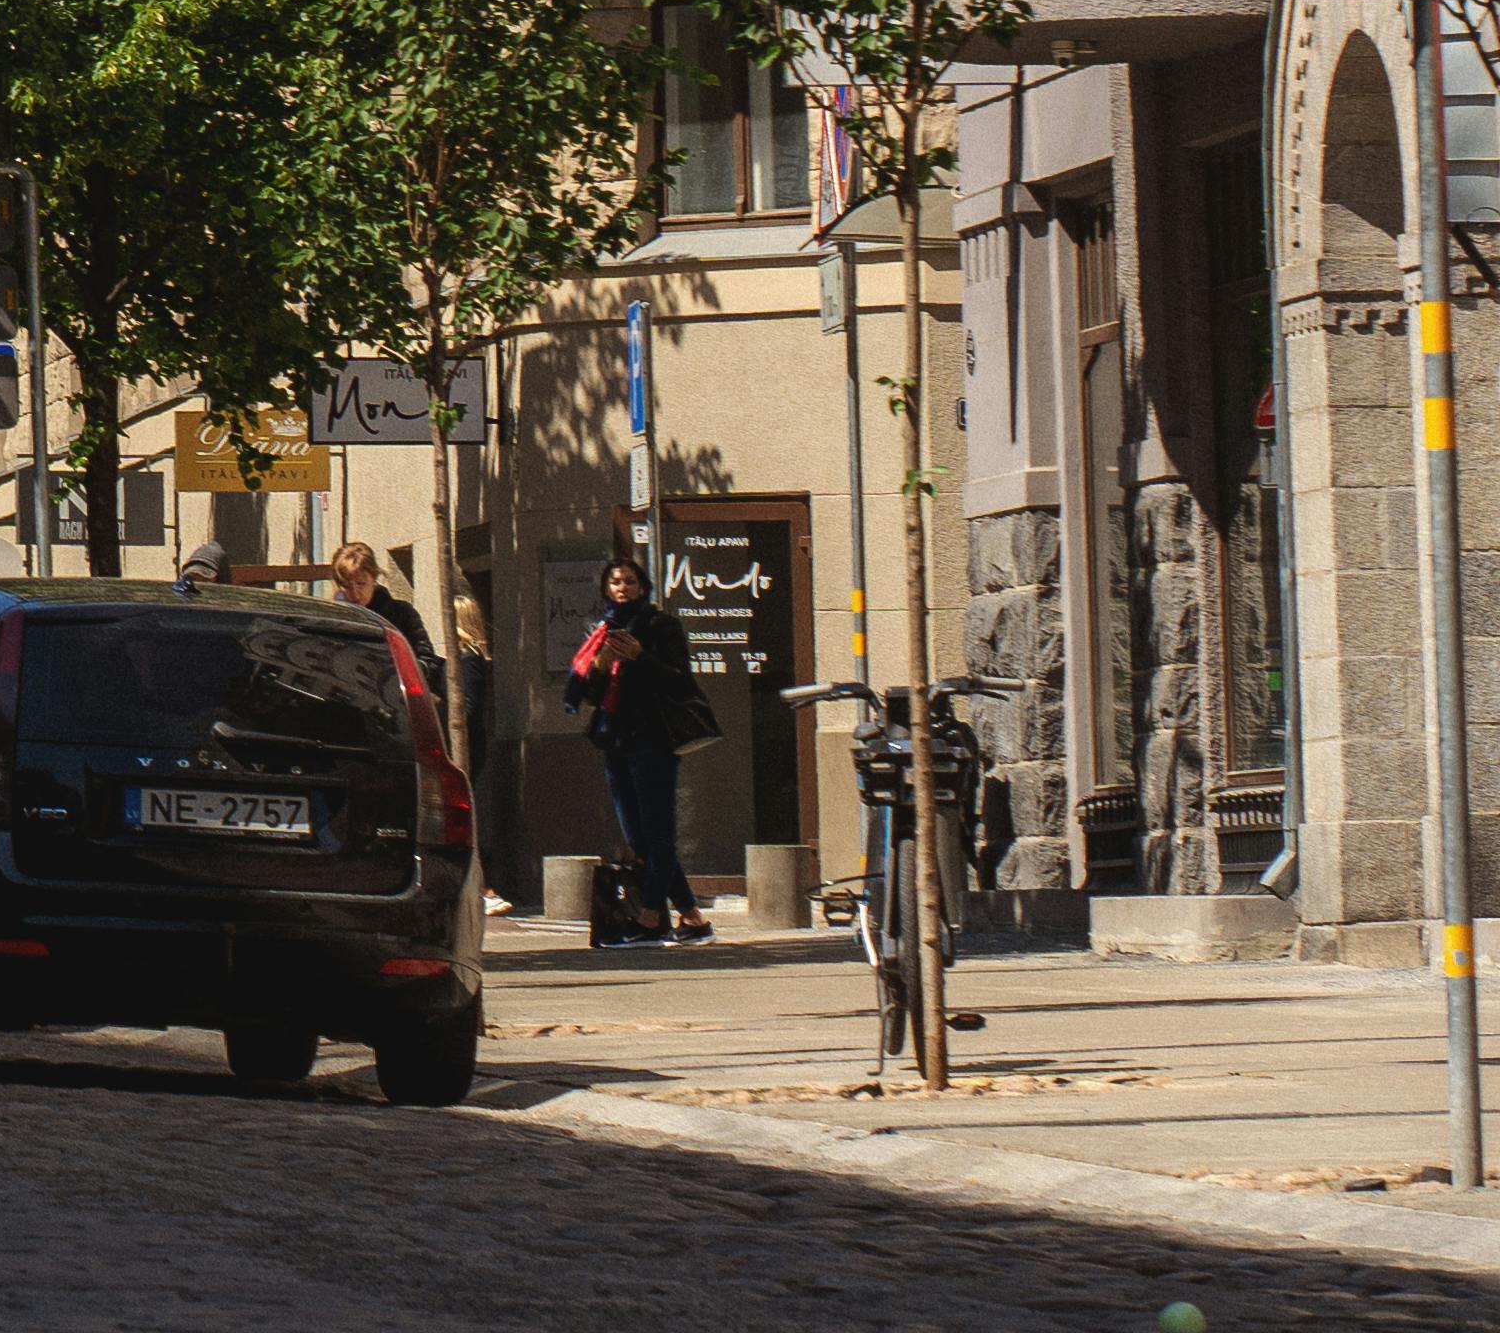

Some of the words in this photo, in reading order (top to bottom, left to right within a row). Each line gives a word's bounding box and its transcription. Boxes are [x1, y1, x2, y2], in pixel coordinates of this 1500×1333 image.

[327, 374, 468, 434] Mon
[664, 552, 773, 601] Mondo
[150, 792, 302, 829] NE-2757
